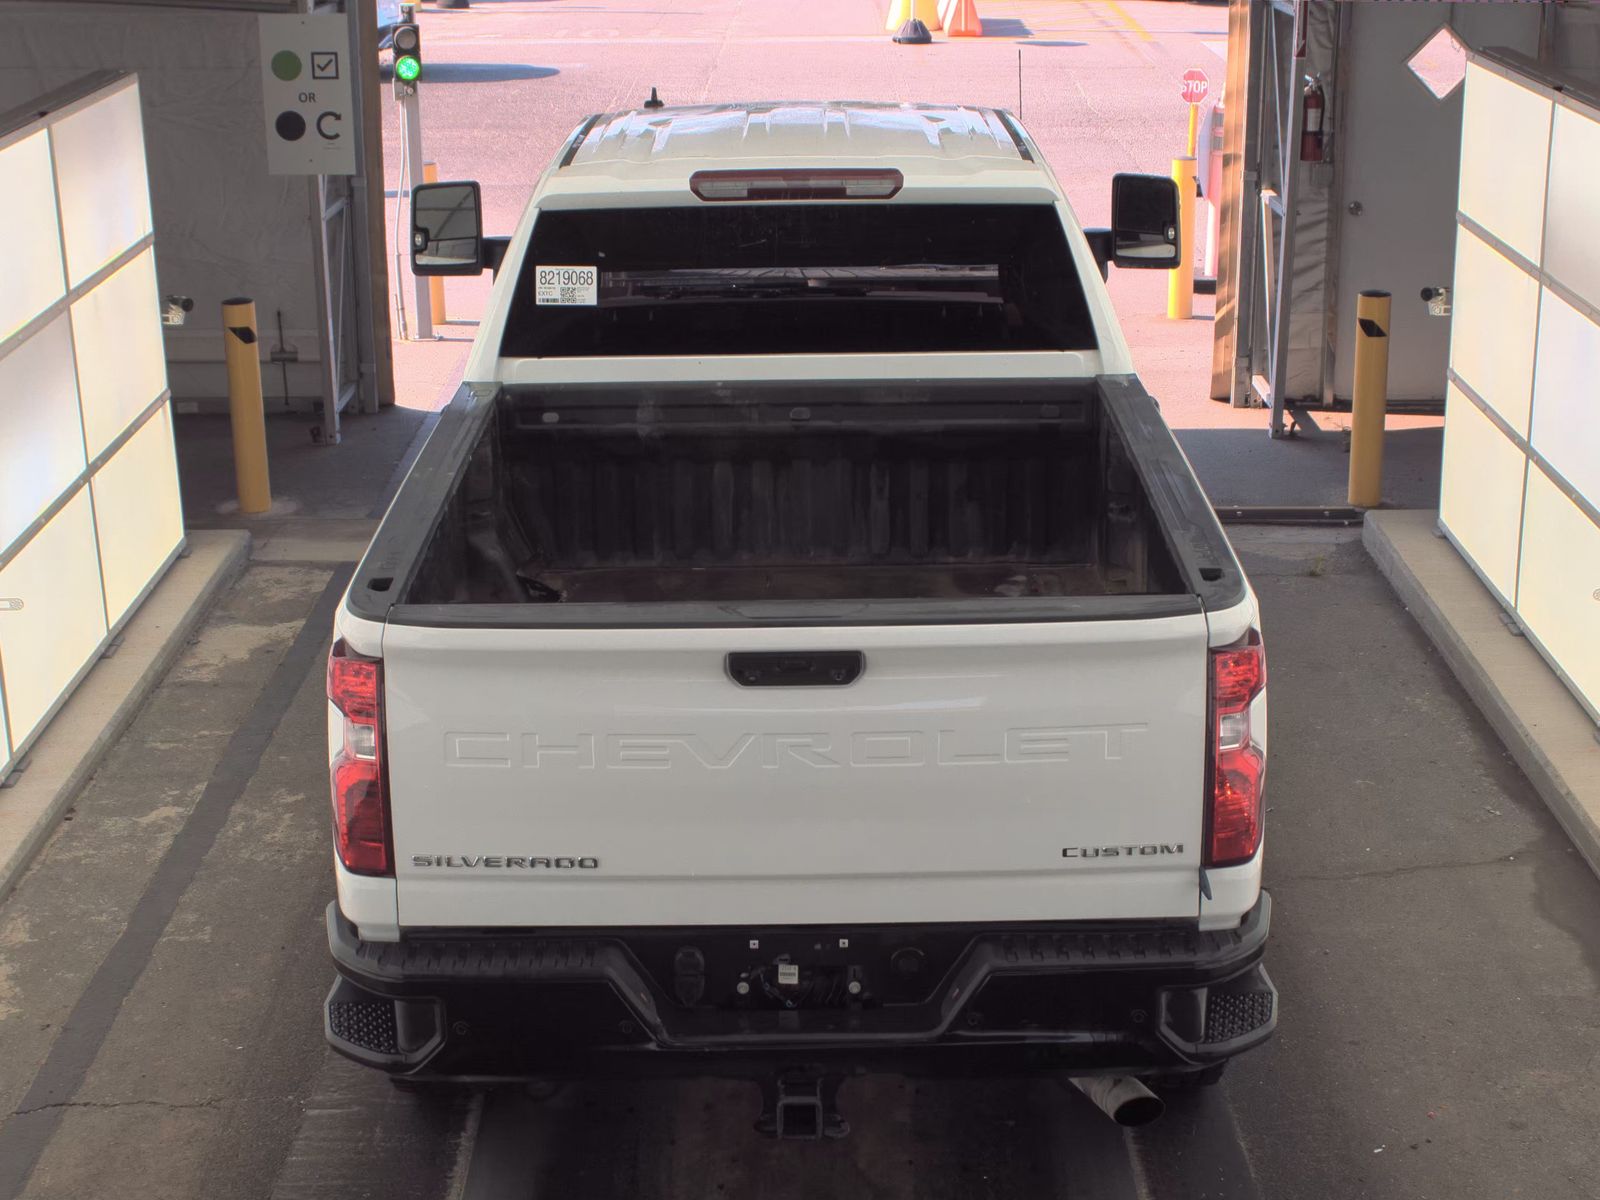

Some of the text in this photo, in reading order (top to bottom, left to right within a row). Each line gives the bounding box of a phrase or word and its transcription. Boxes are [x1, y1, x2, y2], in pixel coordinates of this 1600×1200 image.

[1182, 80, 1207, 93] STOP
[298, 92, 316, 103] OR
[539, 270, 594, 286] 8219068
[444, 721, 1148, 769] CHEVROLET
[1062, 844, 1184, 858] CUSTOM
[411, 855, 599, 869] SILVERADO
